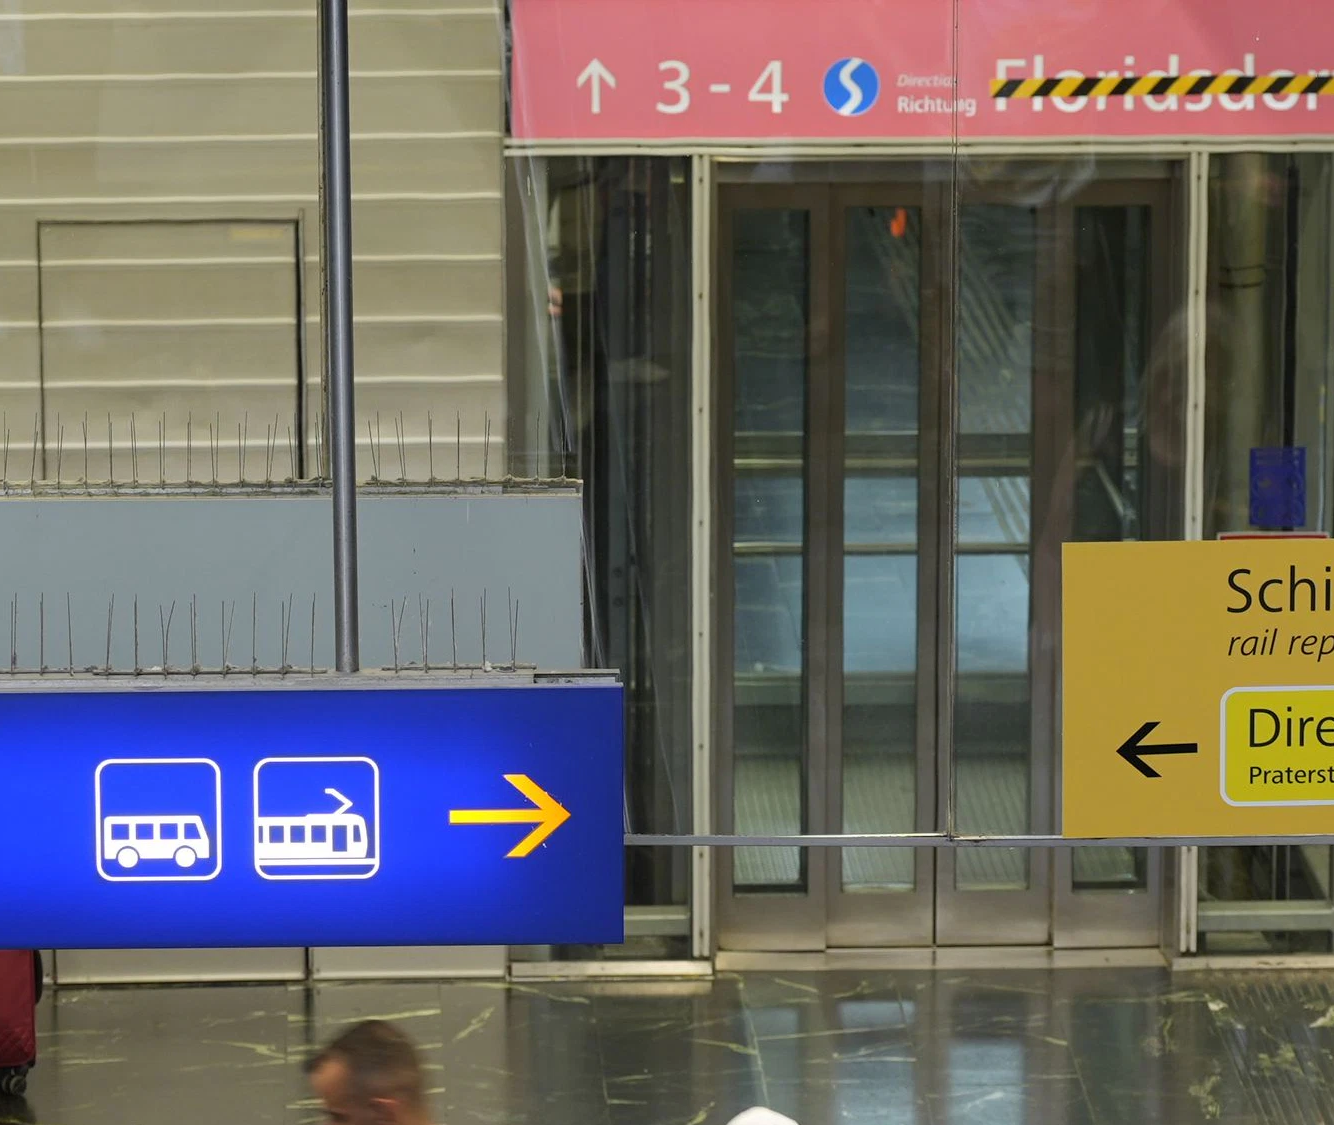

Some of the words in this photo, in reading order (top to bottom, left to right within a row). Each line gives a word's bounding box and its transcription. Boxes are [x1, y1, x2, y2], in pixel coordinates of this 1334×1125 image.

[656, 60, 690, 114] 3
[748, 60, 789, 114] 4
[897, 95, 976, 117] Richtung
[1227, 627, 1278, 657] rail
